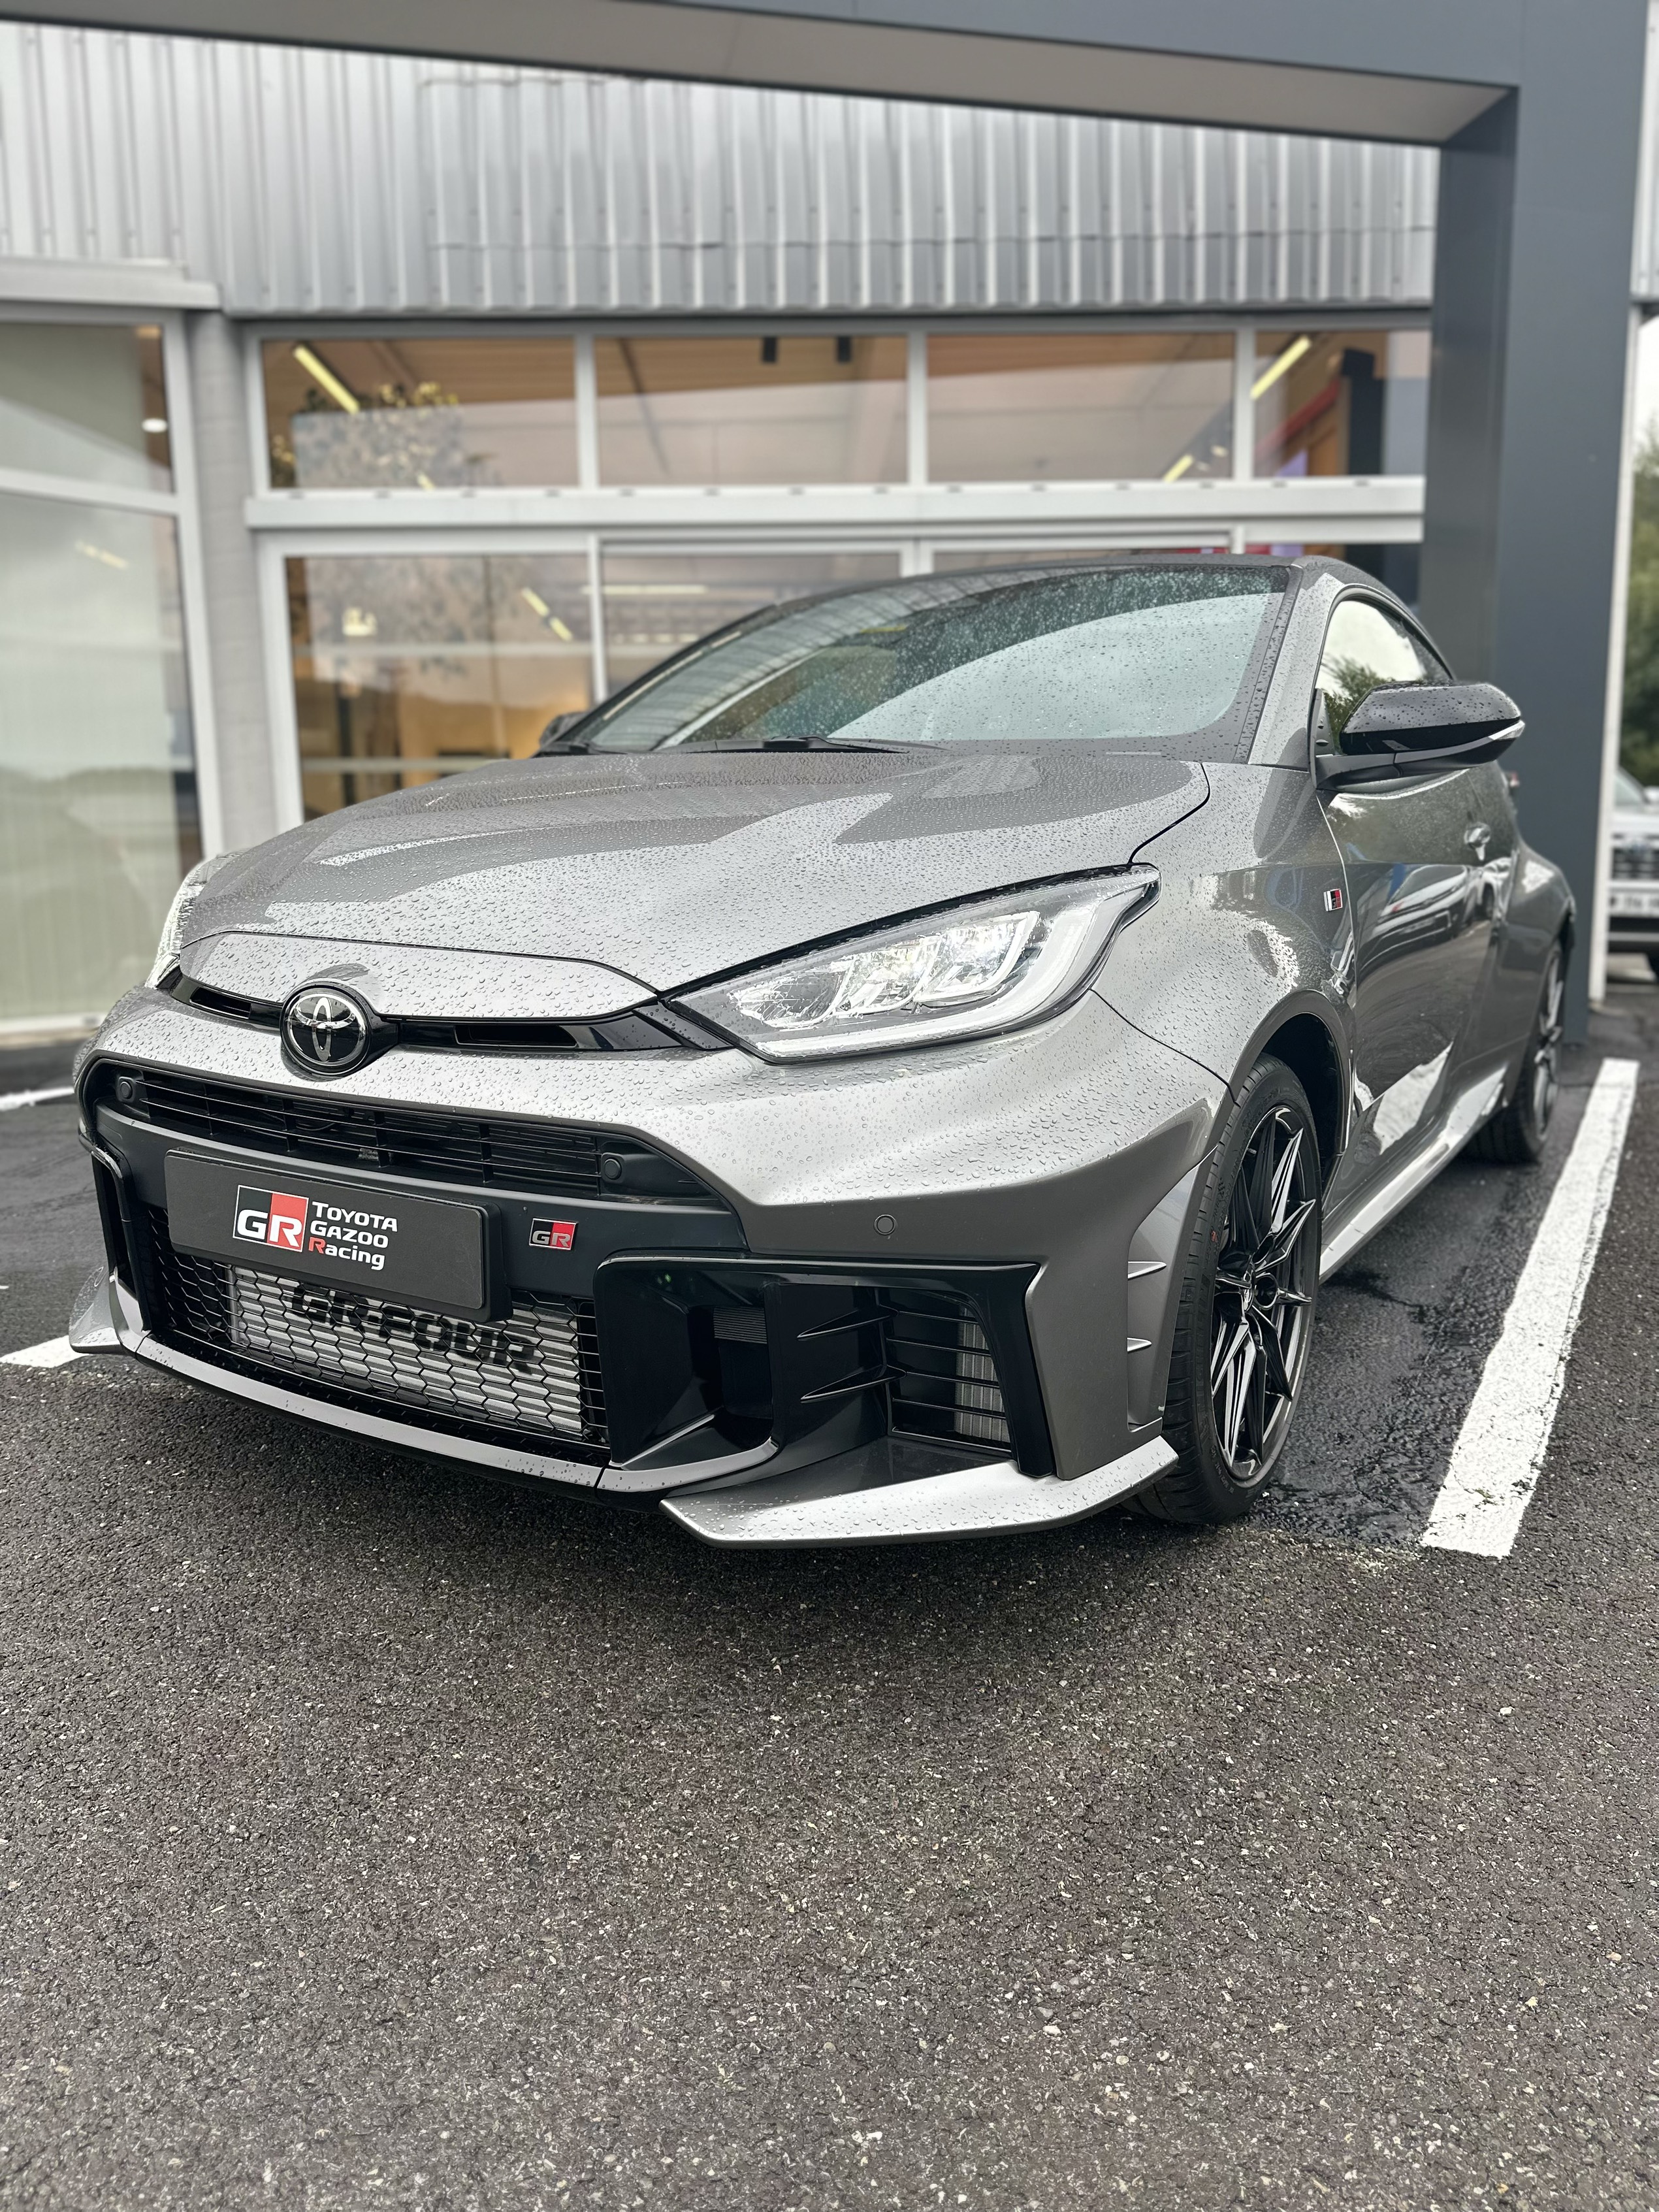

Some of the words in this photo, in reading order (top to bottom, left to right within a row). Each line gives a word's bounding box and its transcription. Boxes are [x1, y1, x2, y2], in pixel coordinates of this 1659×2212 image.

[237, 1209, 303, 1248] GR
[312, 1201, 398, 1232] TOYOTA
[310, 1220, 389, 1248] GAZOO
[532, 1230, 570, 1247] GR
[308, 1237, 385, 1271] Racing
